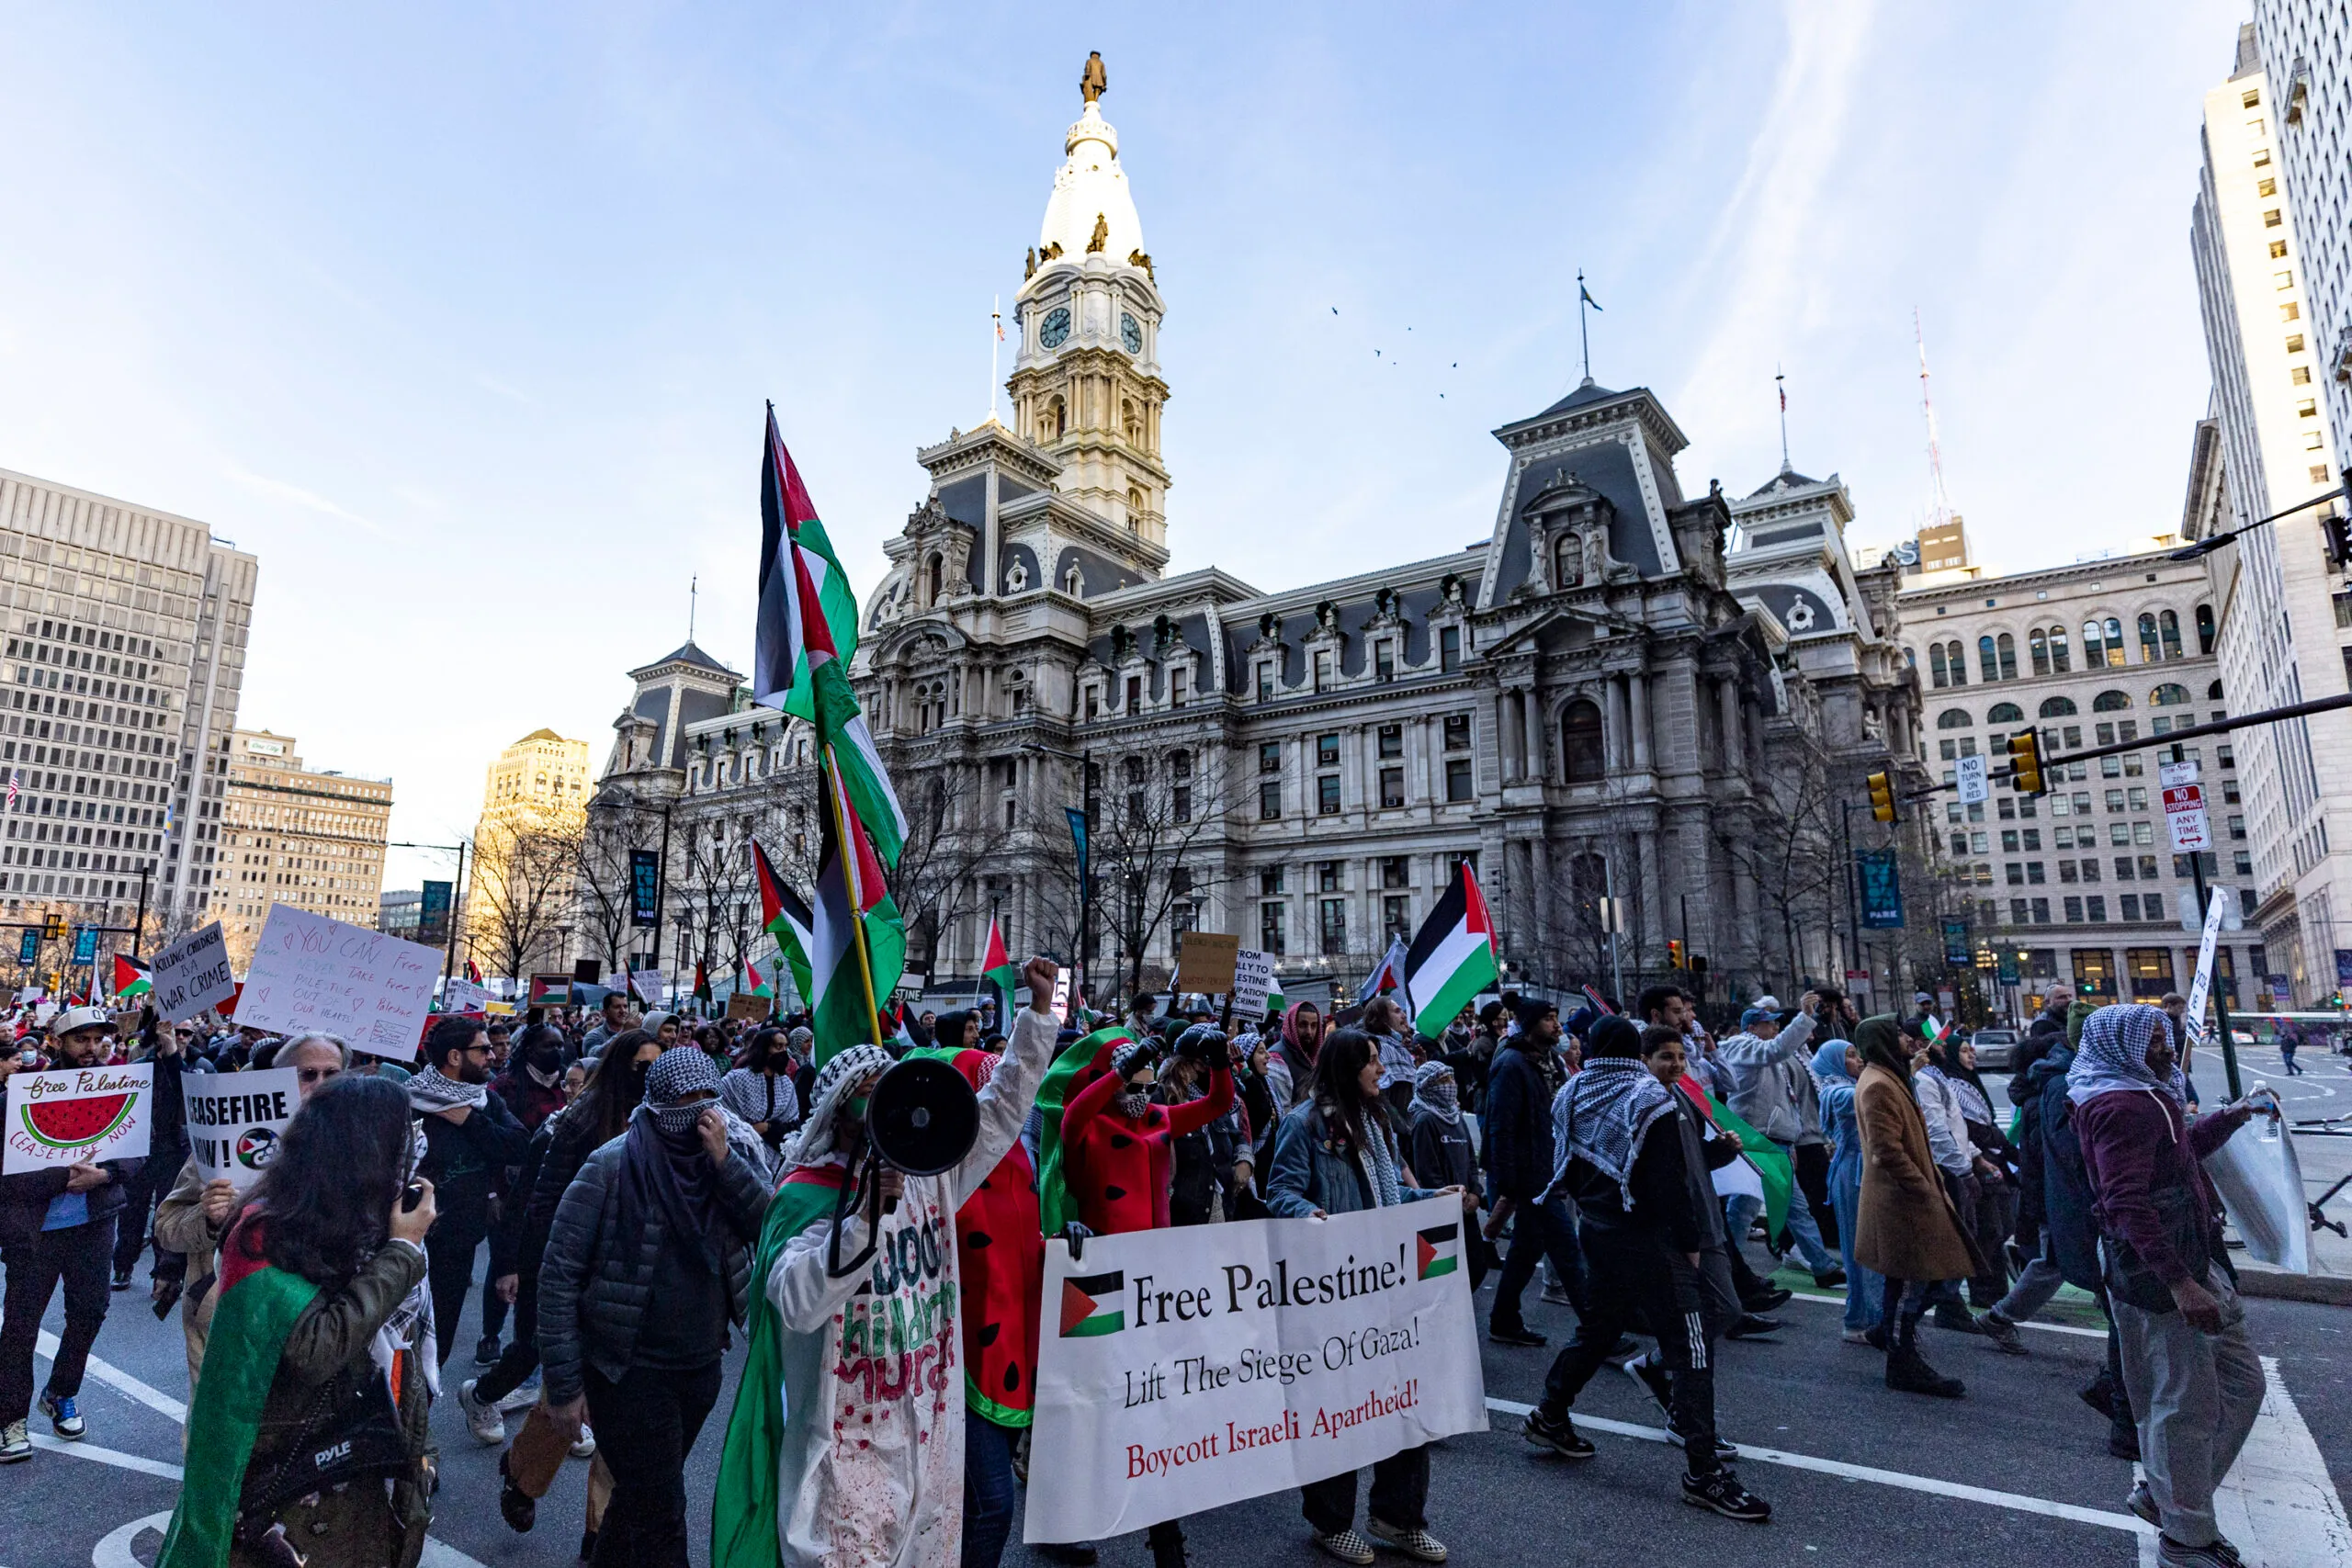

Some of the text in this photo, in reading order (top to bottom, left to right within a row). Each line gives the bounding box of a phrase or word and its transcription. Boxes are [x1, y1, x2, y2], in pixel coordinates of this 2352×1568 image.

[1962, 759, 1978, 772] NO
[1961, 772, 1982, 782] TURN
[1967, 781, 1978, 790] ON
[1966, 790, 1982, 799] RED
[2173, 788, 2188, 802] NO
[2165, 799, 2201, 812] STOPPING
[2176, 814, 2198, 825] ANY
[2177, 825, 2200, 835] TIME
[1869, 909, 1898, 919] PARK
[154, 929, 220, 974] KILLING CHILDREN
[297, 924, 382, 964] YOU CAN
[393, 951, 423, 973] Free
[1256, 964, 1269, 974] TO
[347, 964, 375, 983] TAKE
[159, 960, 230, 1013] WAR CRIME
[385, 977, 411, 993] Free
[293, 987, 323, 1002] OUT
[292, 1001, 315, 1014] OUR
[1235, 997, 1261, 1008] CRIME!
[243, 1005, 272, 1022] Free
[286, 1018, 311, 1032] Free
[75, 1070, 151, 1094] Palestine
[187, 1091, 289, 1126] CEASEFIRE
[9, 1114, 137, 1160] CEASEFIRE NOW
[1133, 1242, 1407, 1328] Free Palestine!
[1124, 1315, 1420, 1409] Lift The Siege Of Gaza!
[1126, 1378, 1420, 1480] Boycott Israeli Apartheid!
[315, 1440, 351, 1466] PYLE
